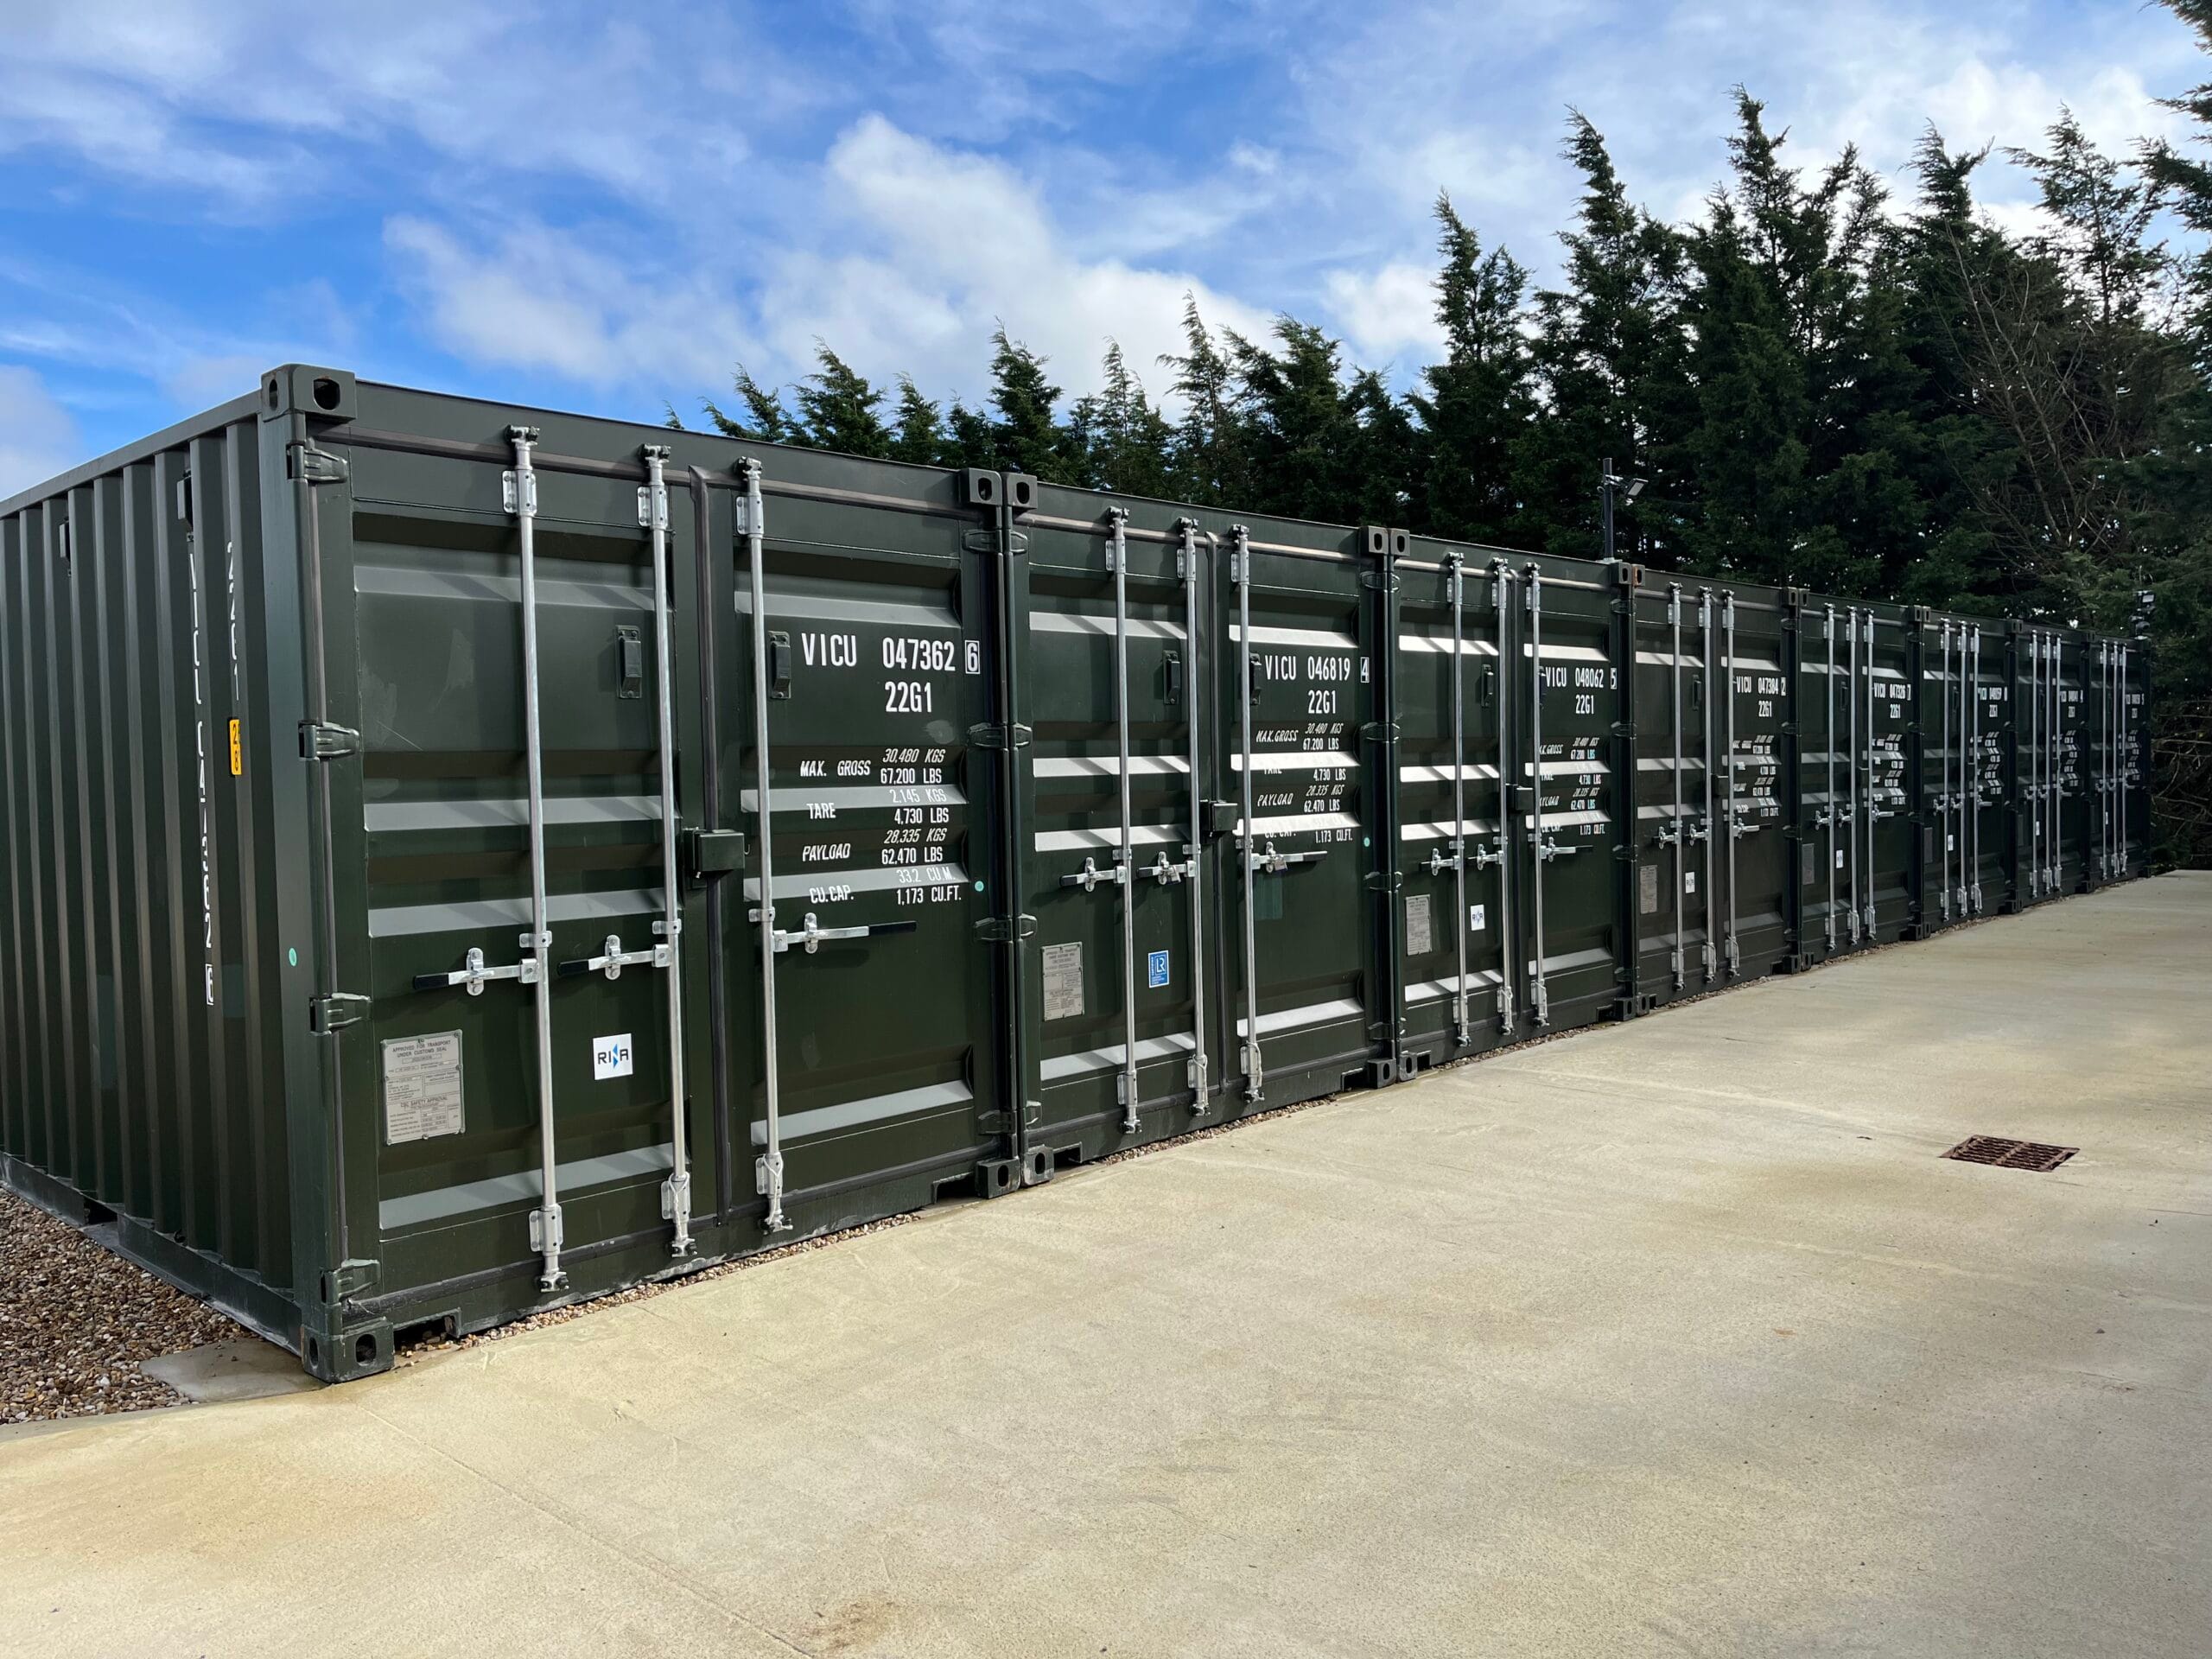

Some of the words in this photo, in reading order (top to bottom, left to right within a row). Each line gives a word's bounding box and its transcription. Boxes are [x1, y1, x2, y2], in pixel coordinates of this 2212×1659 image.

[801, 632, 857, 667] VICU
[882, 637, 956, 671] 047362
[965, 640, 980, 674] 6
[1264, 655, 1297, 681] VICU
[1307, 656, 1351, 681] 046819
[1361, 658, 1370, 683] 4
[1545, 666, 1567, 688] VICU
[1574, 667, 1605, 689] 048062
[1736, 676, 1752, 694] VICU
[885, 681, 932, 713] 22G1
[1307, 690, 1337, 715] 22G1
[1575, 694, 1594, 715] 22G1
[1330, 722, 1344, 734] KGS
[1328, 737, 1339, 750] LBS
[882, 748, 919, 763] 30,480
[925, 748, 946, 763] KGS
[800, 760, 827, 777] MAX.
[837, 760, 871, 777] GROSS
[880, 768, 916, 785] 67,200
[923, 768, 942, 785] LBS
[1335, 768, 1346, 781] LBS
[925, 788, 947, 803] KGS
[1331, 785, 1344, 795] KGS
[1257, 792, 1294, 807] PAYLOAD
[1329, 799, 1340, 811] LBS
[806, 803, 836, 820] TARE
[931, 808, 950, 823] LBS
[884, 829, 921, 844] 28,335
[926, 828, 947, 842] KGS
[802, 843, 851, 861] PAYLOAD
[925, 847, 943, 862] LBS
[931, 886, 962, 903] CU.FT.
